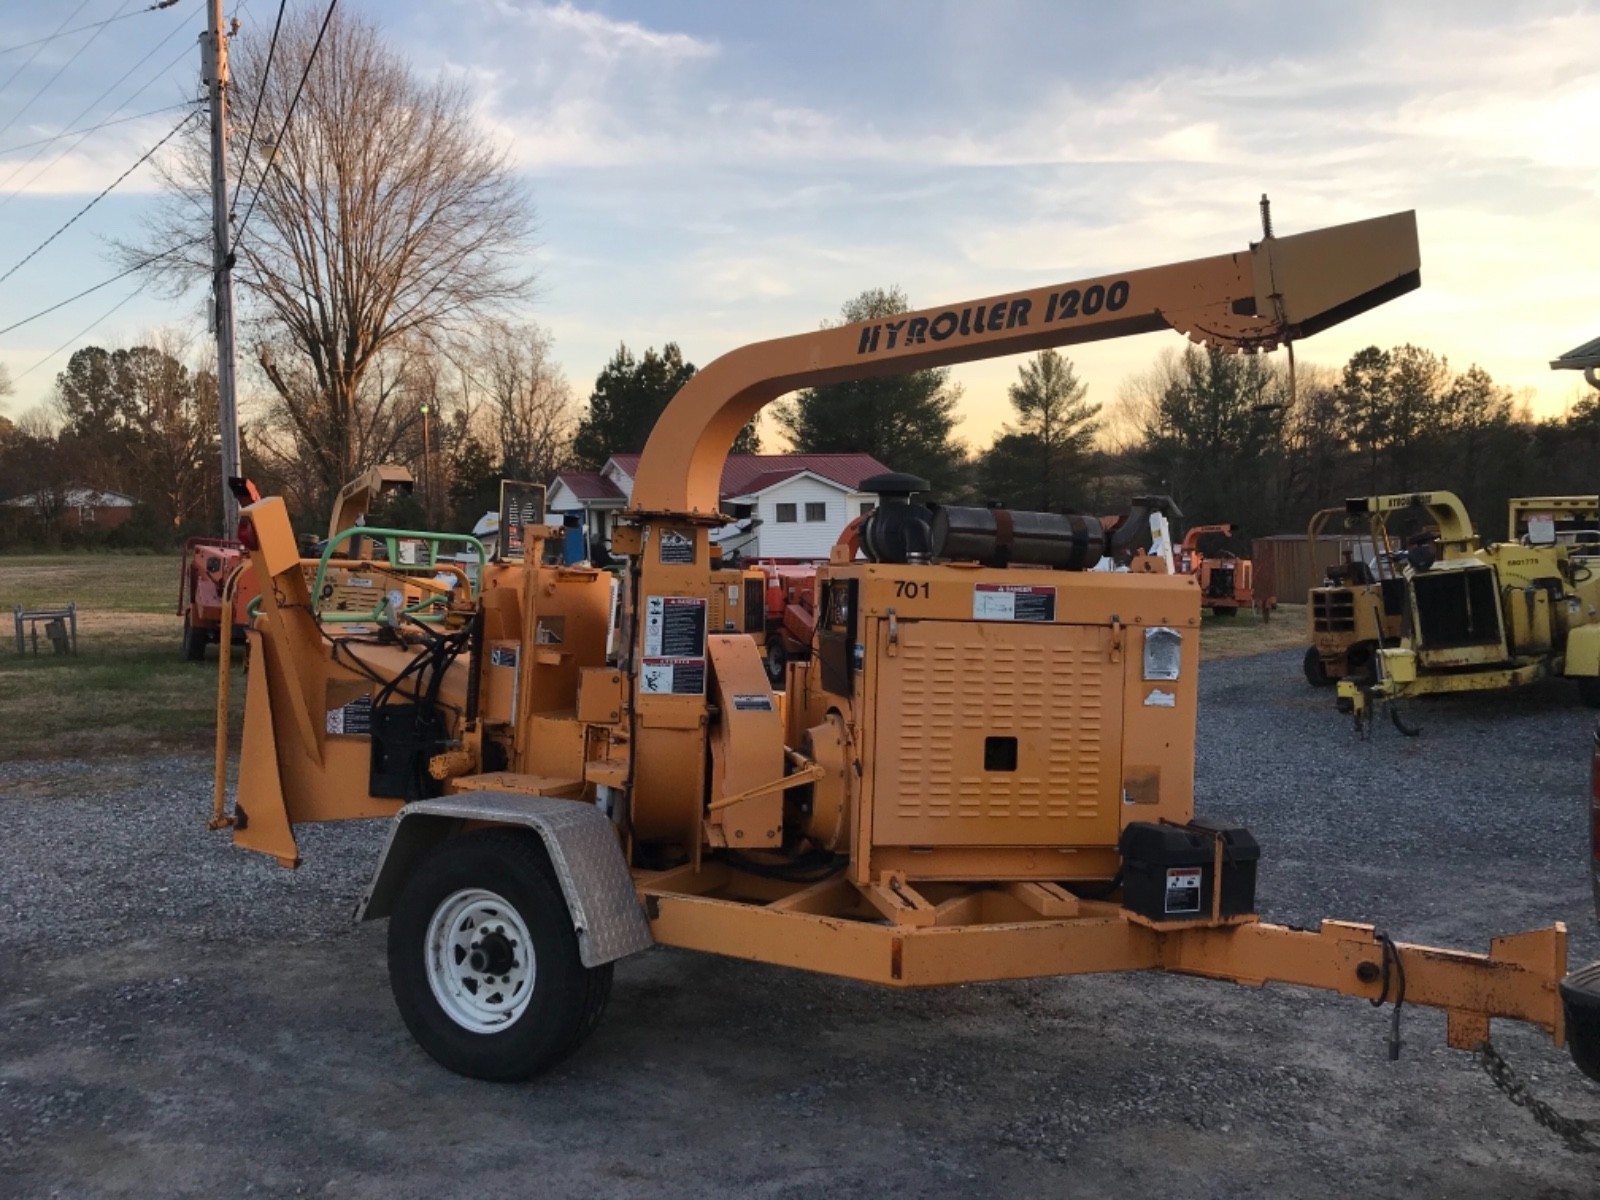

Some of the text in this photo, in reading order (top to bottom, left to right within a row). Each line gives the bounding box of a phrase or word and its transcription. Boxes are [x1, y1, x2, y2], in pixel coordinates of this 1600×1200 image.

[857, 280, 1130, 355] HYROLLER 1200
[894, 580, 929, 599] 701
